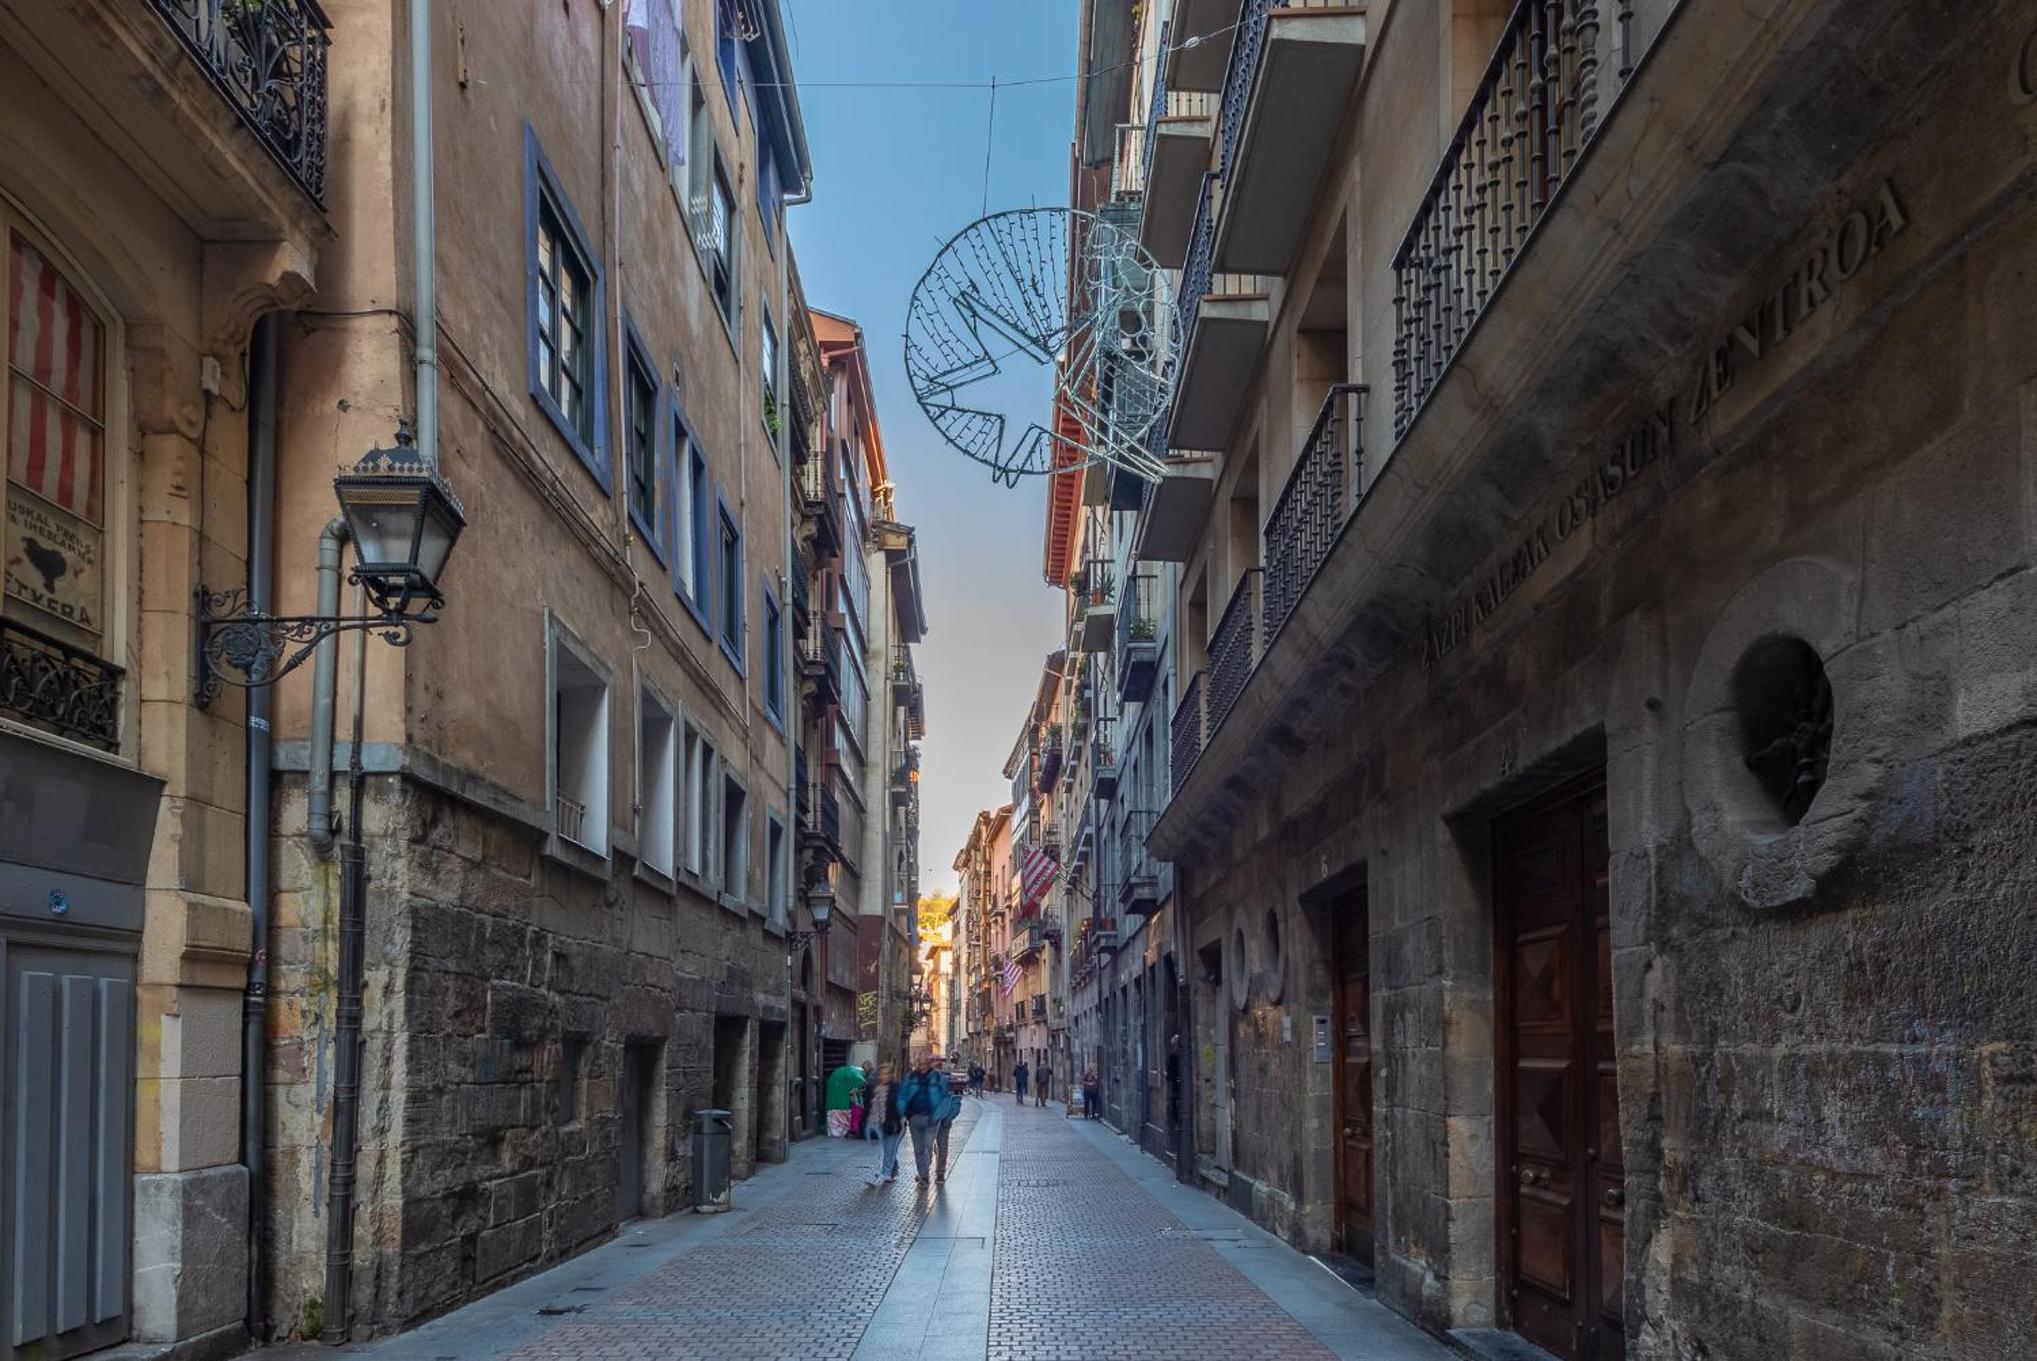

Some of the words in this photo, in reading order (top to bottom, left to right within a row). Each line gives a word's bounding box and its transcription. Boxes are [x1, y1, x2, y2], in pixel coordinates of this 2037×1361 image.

[1556, 398, 1676, 541] OSASUN
[7, 499, 52, 528] USKAL
[1321, 854, 1329, 879] 6
